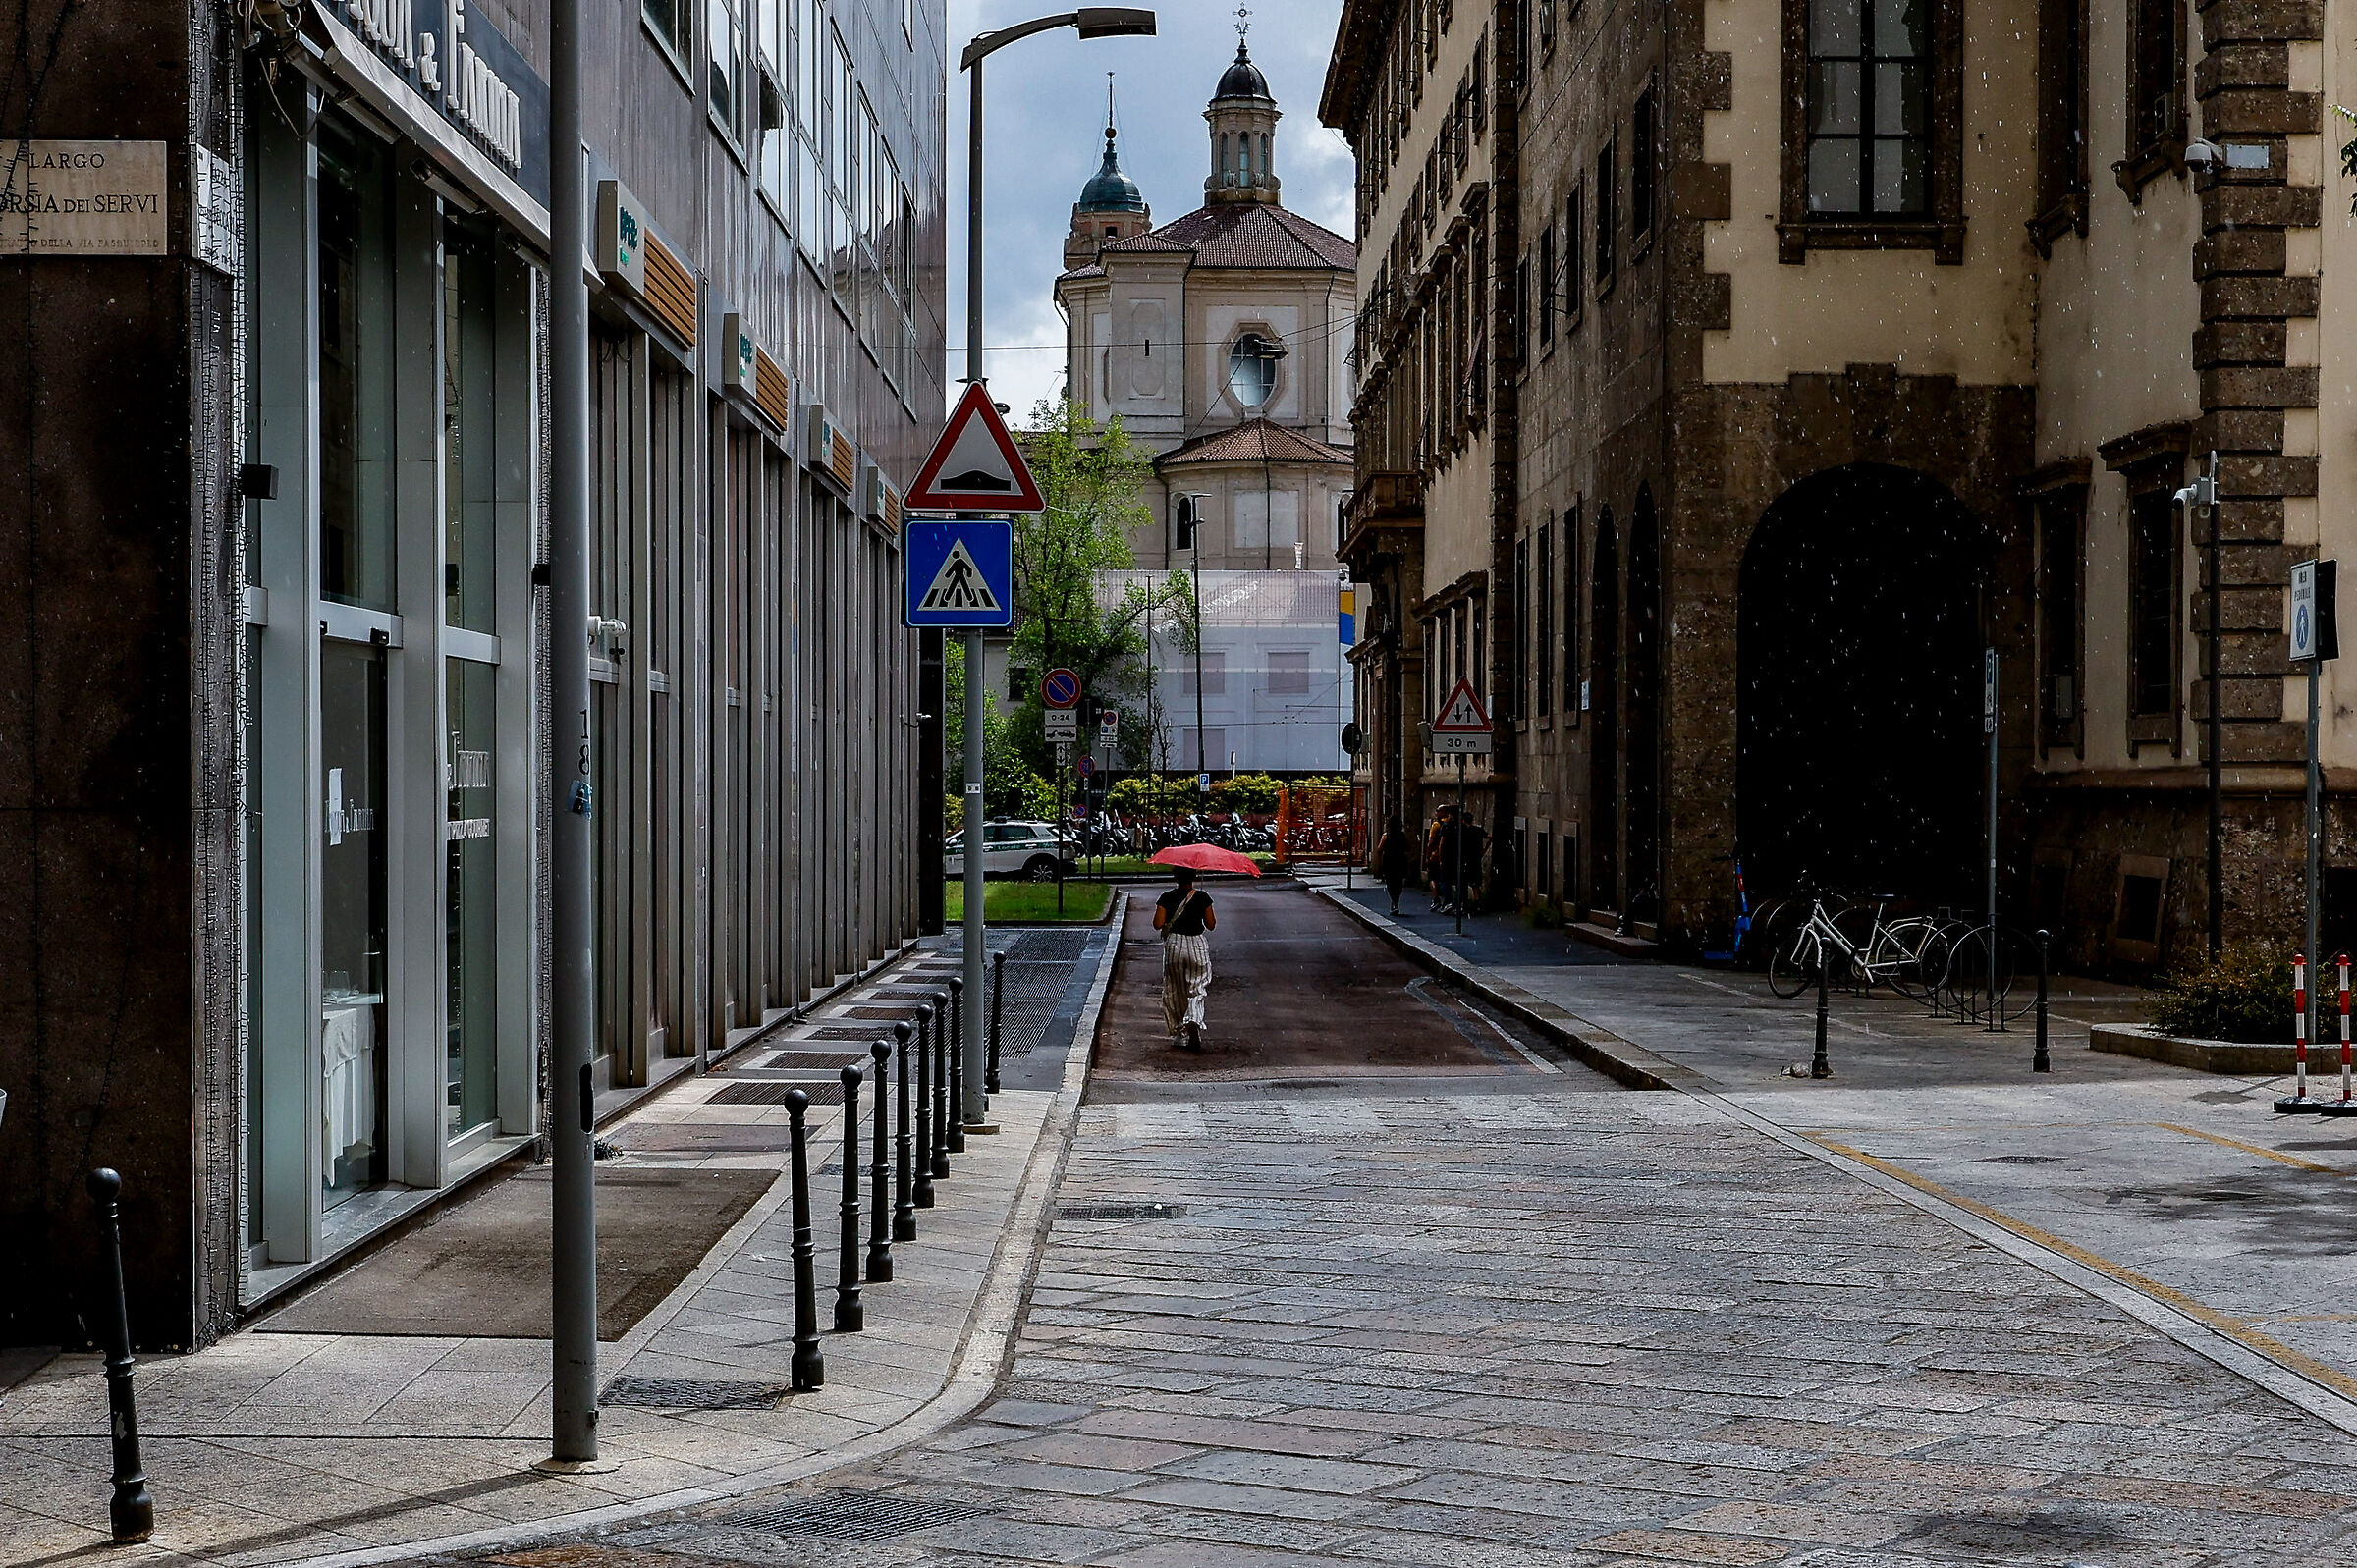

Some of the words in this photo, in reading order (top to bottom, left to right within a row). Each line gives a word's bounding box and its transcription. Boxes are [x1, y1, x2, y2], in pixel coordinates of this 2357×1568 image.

[419, 32, 441, 92] &
[29, 153, 105, 169] LARGO
[64, 199, 89, 213] DEI
[94, 194, 158, 213] SERVI
[41, 239, 72, 248] DELLA
[578, 708, 590, 776] 18
[1447, 738, 1462, 747] 30
